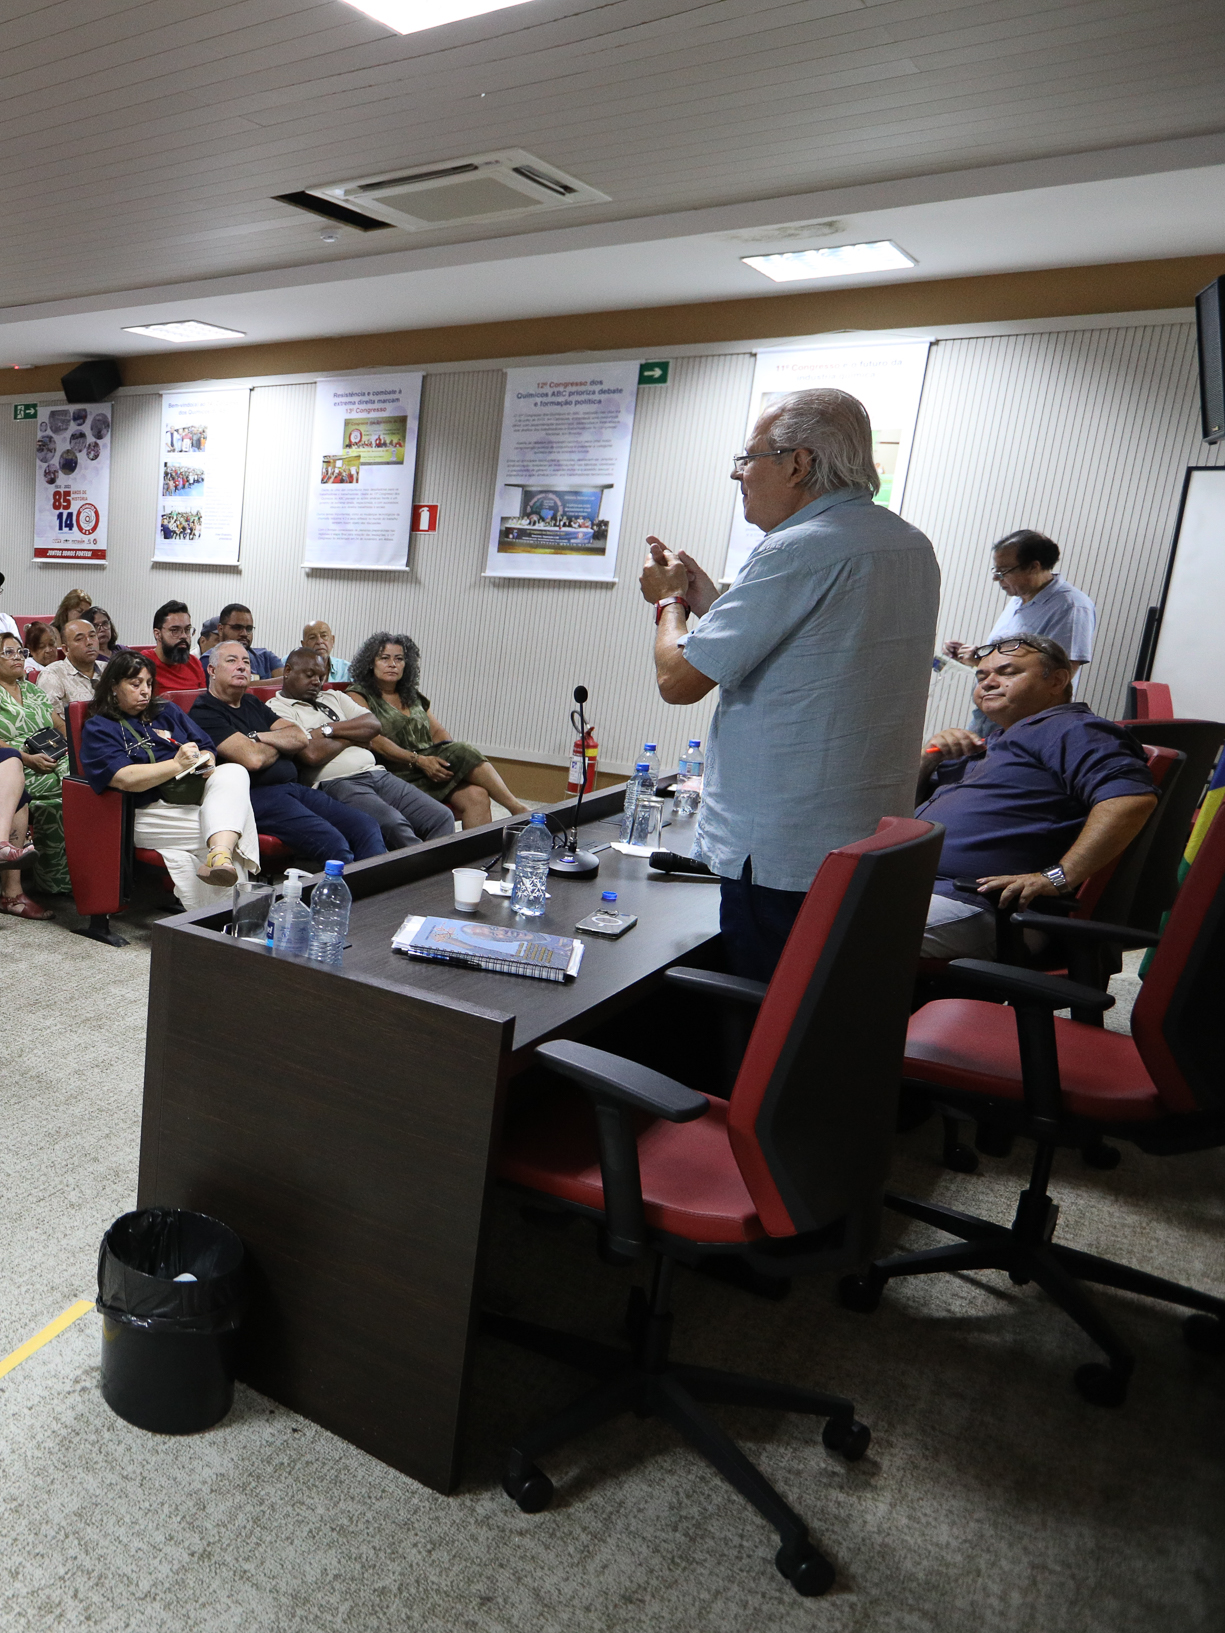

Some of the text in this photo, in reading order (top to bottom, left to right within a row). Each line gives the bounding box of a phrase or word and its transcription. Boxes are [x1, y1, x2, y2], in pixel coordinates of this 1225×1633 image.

[792, 363, 840, 372] Congresso
[549, 380, 588, 389] Congresso
[516, 390, 549, 399] Químicos
[568, 388, 596, 397] prioriza
[598, 387, 624, 395] debate
[540, 400, 573, 408] formação
[574, 398, 602, 406] política
[52, 490, 71, 510] 85
[57, 511, 74, 531] 14
